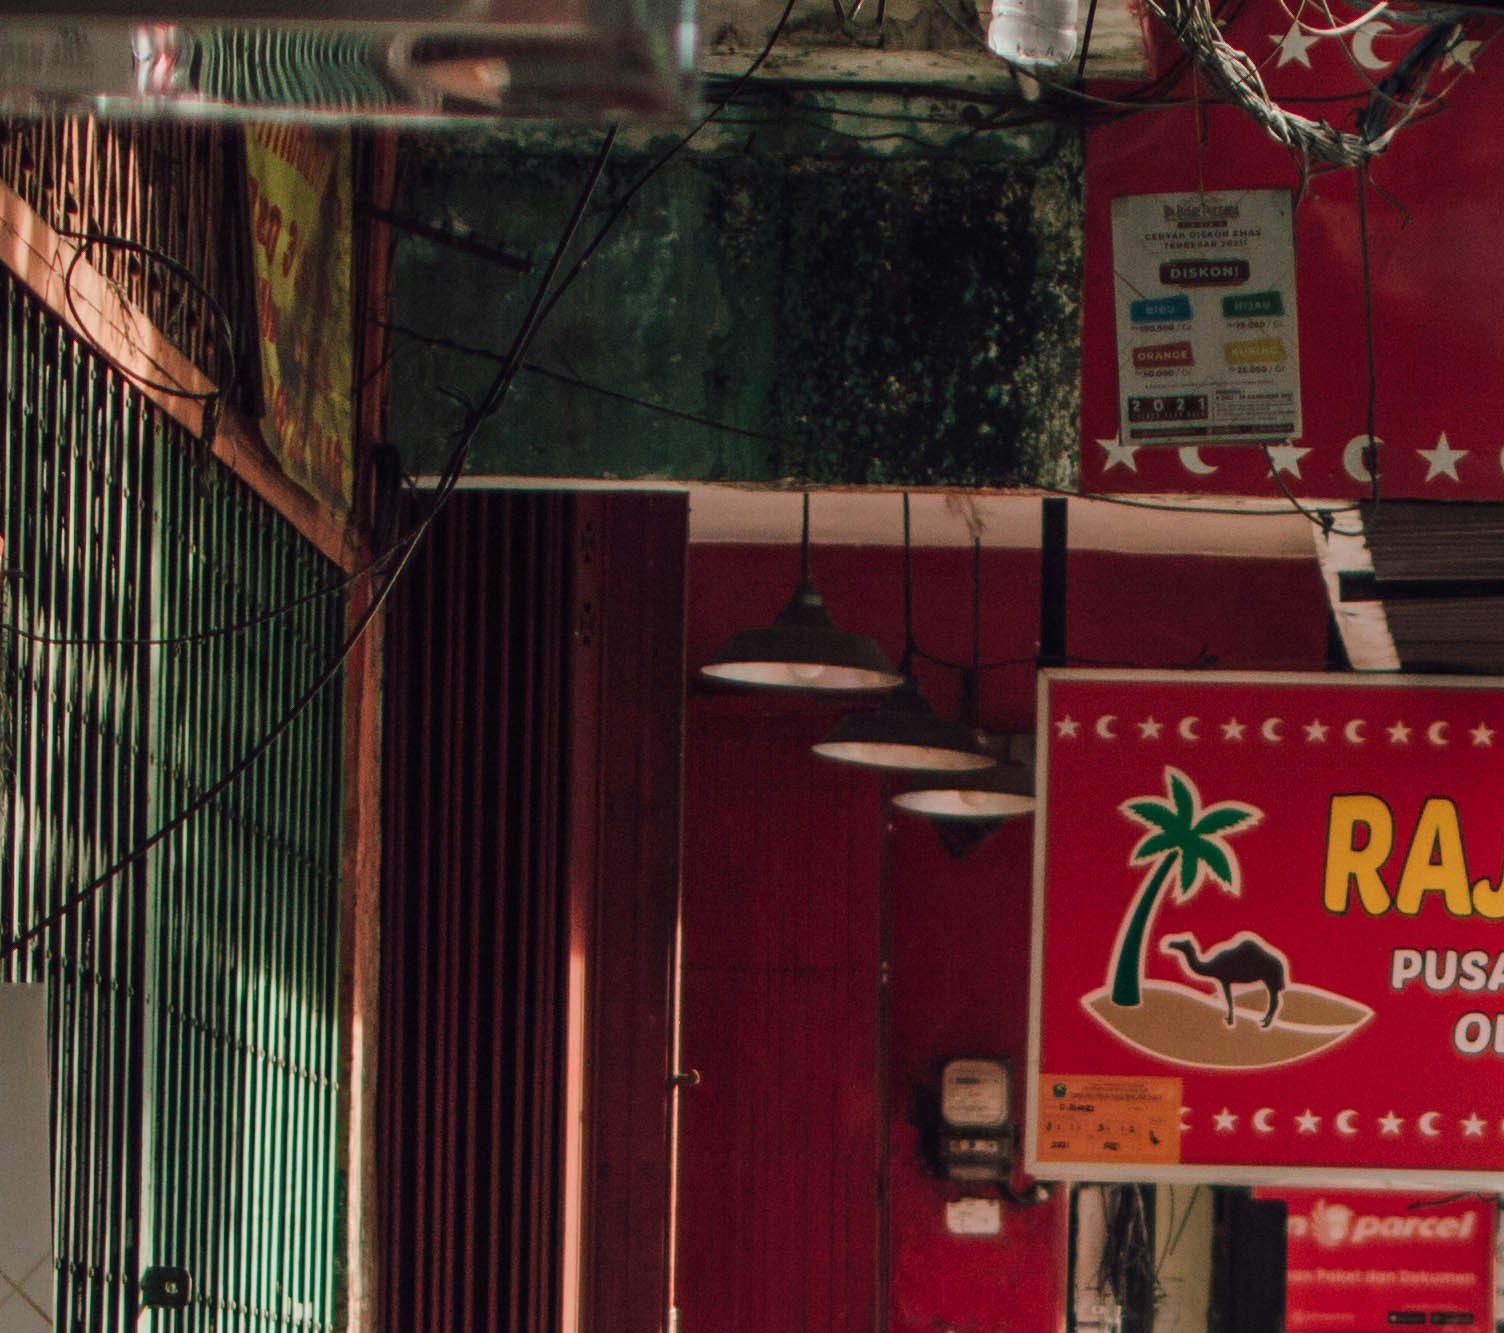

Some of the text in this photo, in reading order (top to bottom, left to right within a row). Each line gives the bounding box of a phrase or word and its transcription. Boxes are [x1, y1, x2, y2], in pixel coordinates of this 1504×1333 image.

[1170, 267, 1239, 279] DISKON!
[1137, 351, 1188, 360] ORANGE
[1352, 1210, 1477, 1243] parcel
